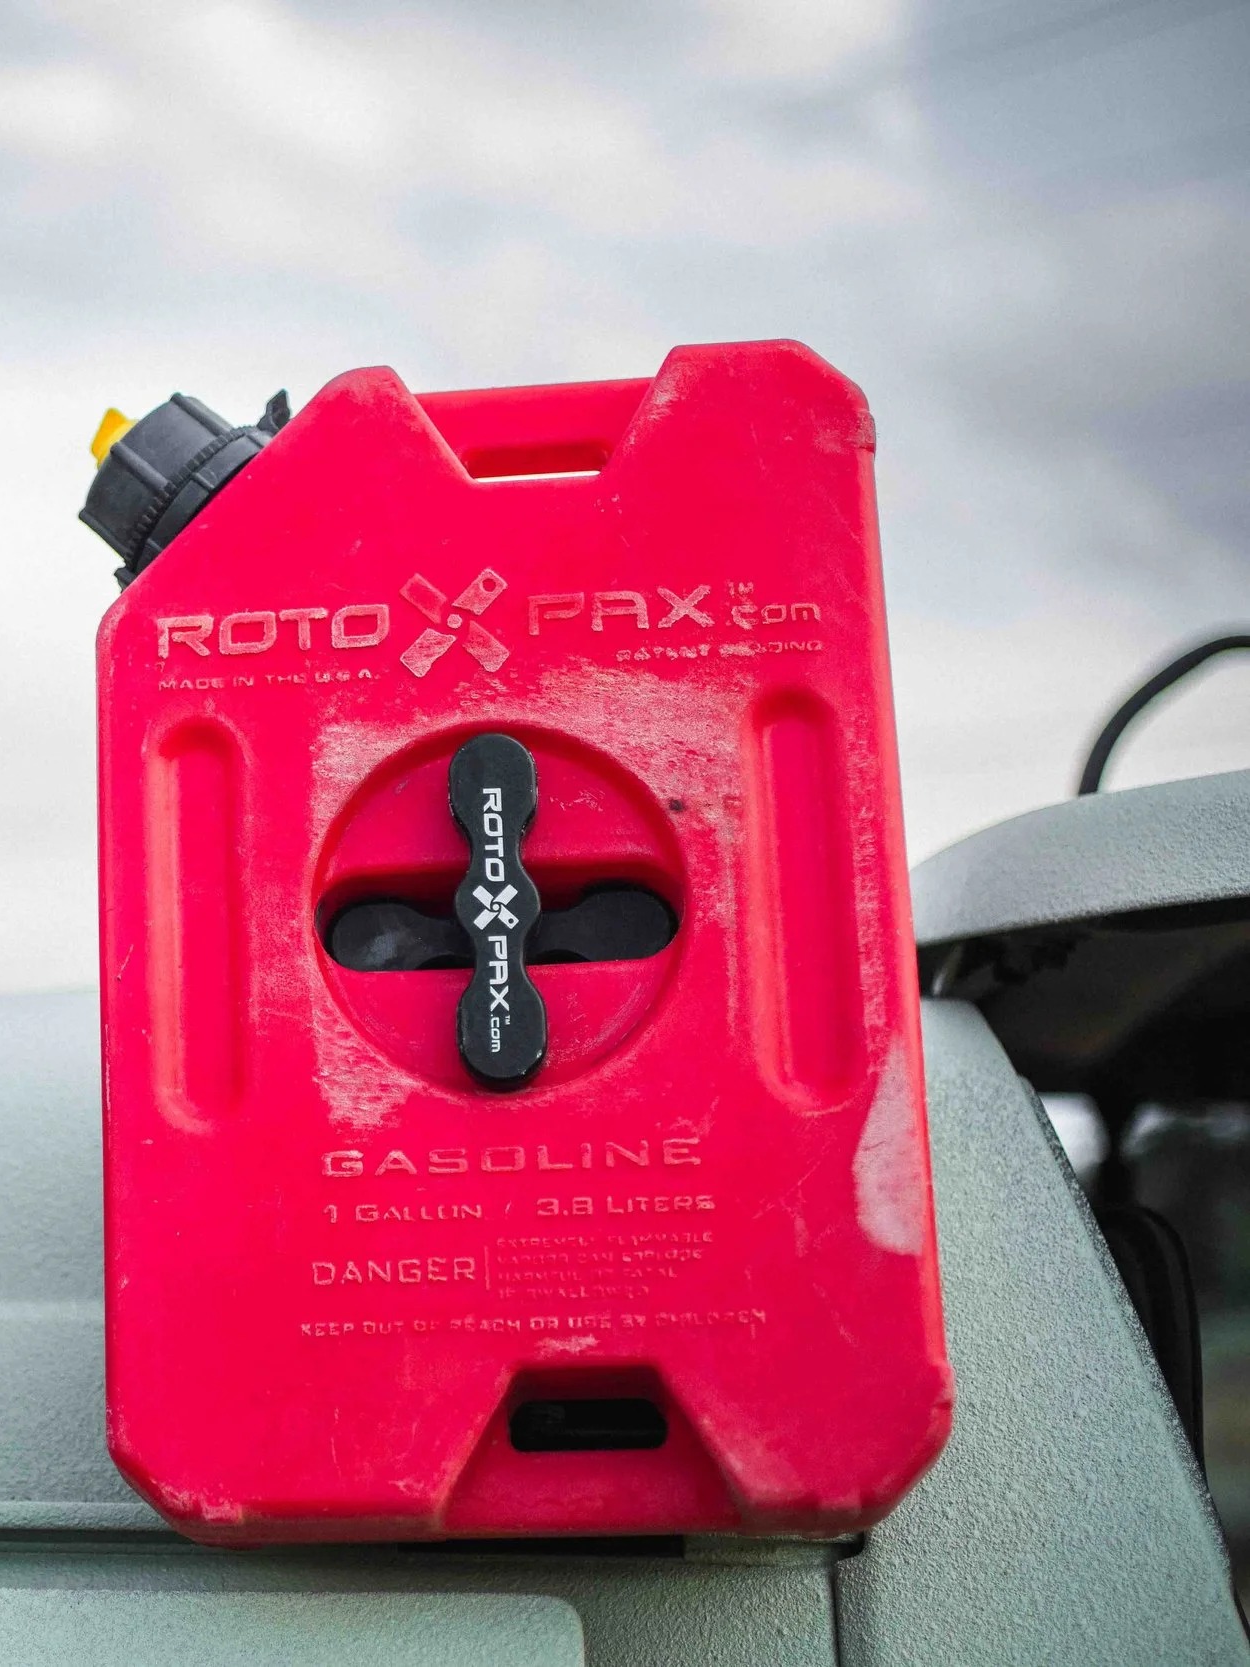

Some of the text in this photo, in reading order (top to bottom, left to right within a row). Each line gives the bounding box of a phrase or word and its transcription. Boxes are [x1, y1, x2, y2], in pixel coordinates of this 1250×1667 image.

[156, 603, 390, 660] ROTO
[158, 675, 226, 692] MADE
[232, 675, 255, 688] IN
[264, 673, 308, 686] THE
[482, 786, 506, 883] ROTO
[321, 1136, 702, 1178] GASOLINE
[323, 1203, 338, 1224] 1
[354, 1203, 483, 1223] GALLON
[536, 1197, 594, 1217] 3.8
[606, 1194, 717, 1216] LITERS
[311, 1255, 477, 1286] DANGER
[300, 1321, 355, 1337] KEEP
[362, 1320, 404, 1335] OUT
[529, 1315, 559, 1331] OR
[567, 1312, 612, 1329] USE
